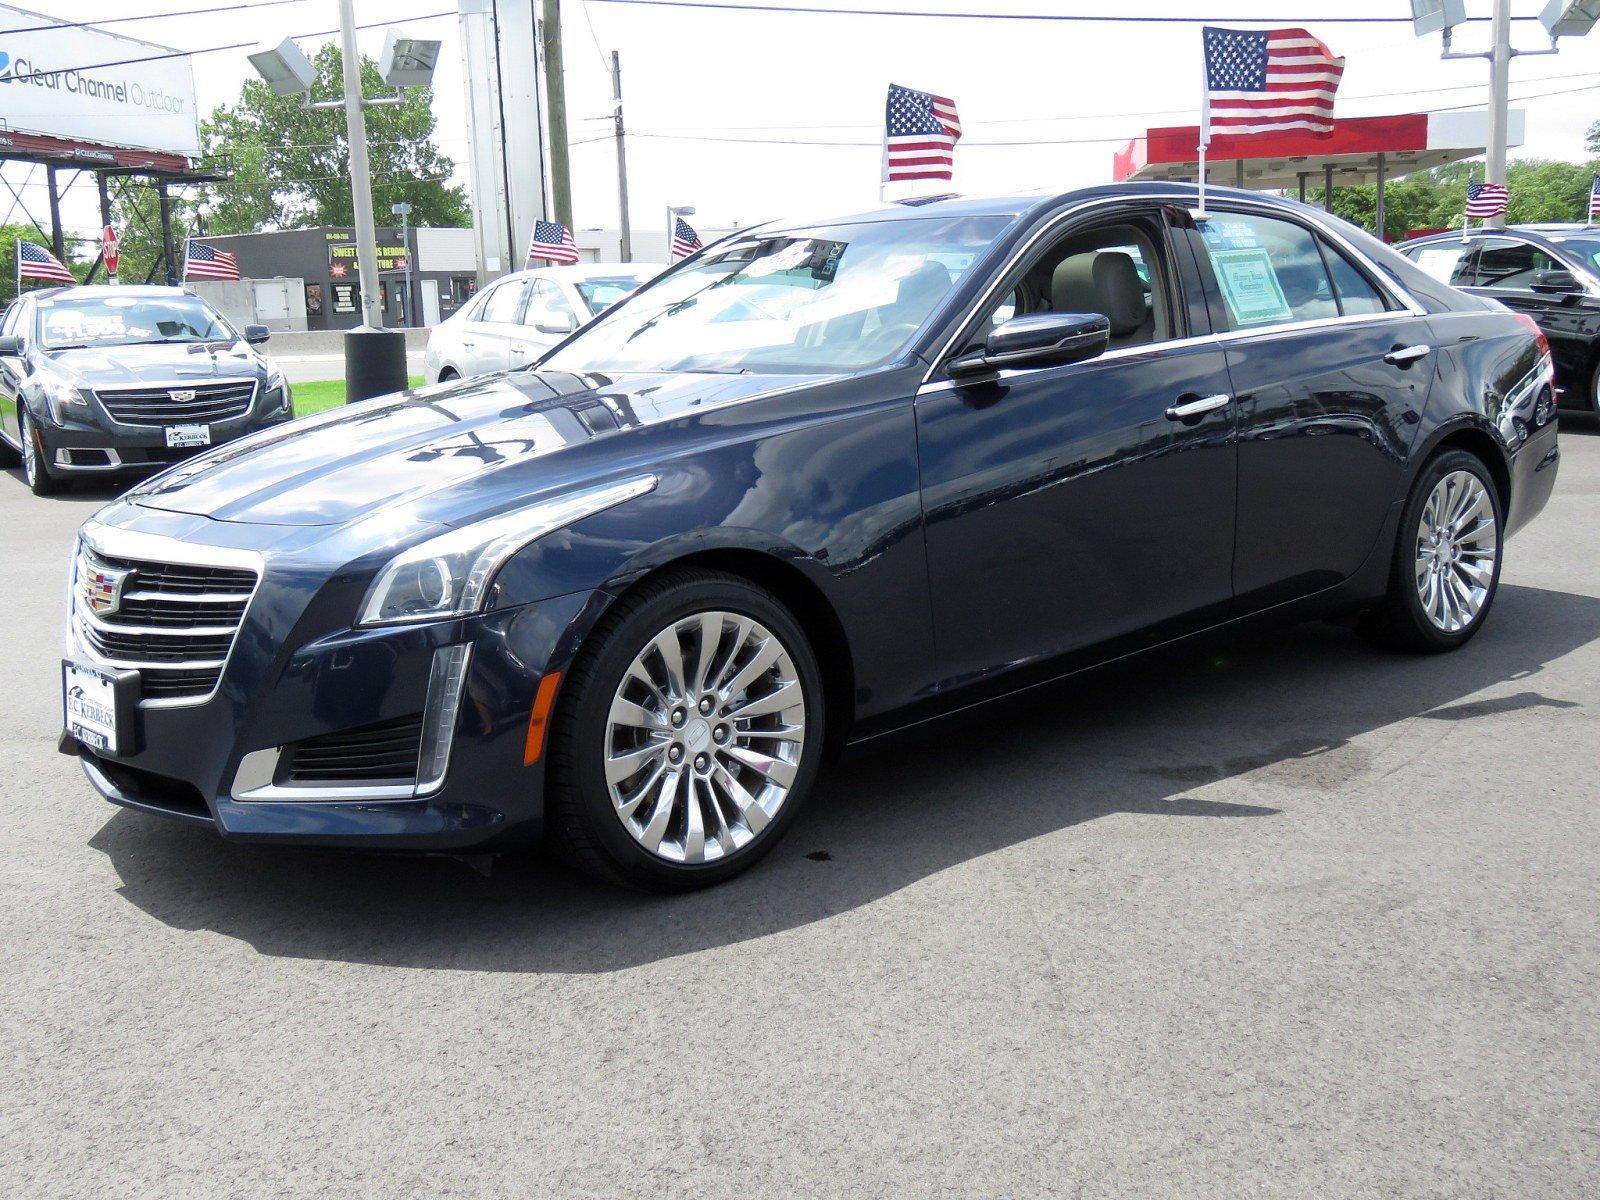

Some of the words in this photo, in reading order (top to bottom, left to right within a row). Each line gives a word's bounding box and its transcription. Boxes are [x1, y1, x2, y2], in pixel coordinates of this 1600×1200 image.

[15, 58, 61, 90] Clear
[65, 71, 128, 103] Channel
[131, 83, 184, 114] Outdoor
[103, 241, 117, 259] STOP
[333, 247, 354, 257] SWEET
[81, 702, 115, 730] KERBECK
